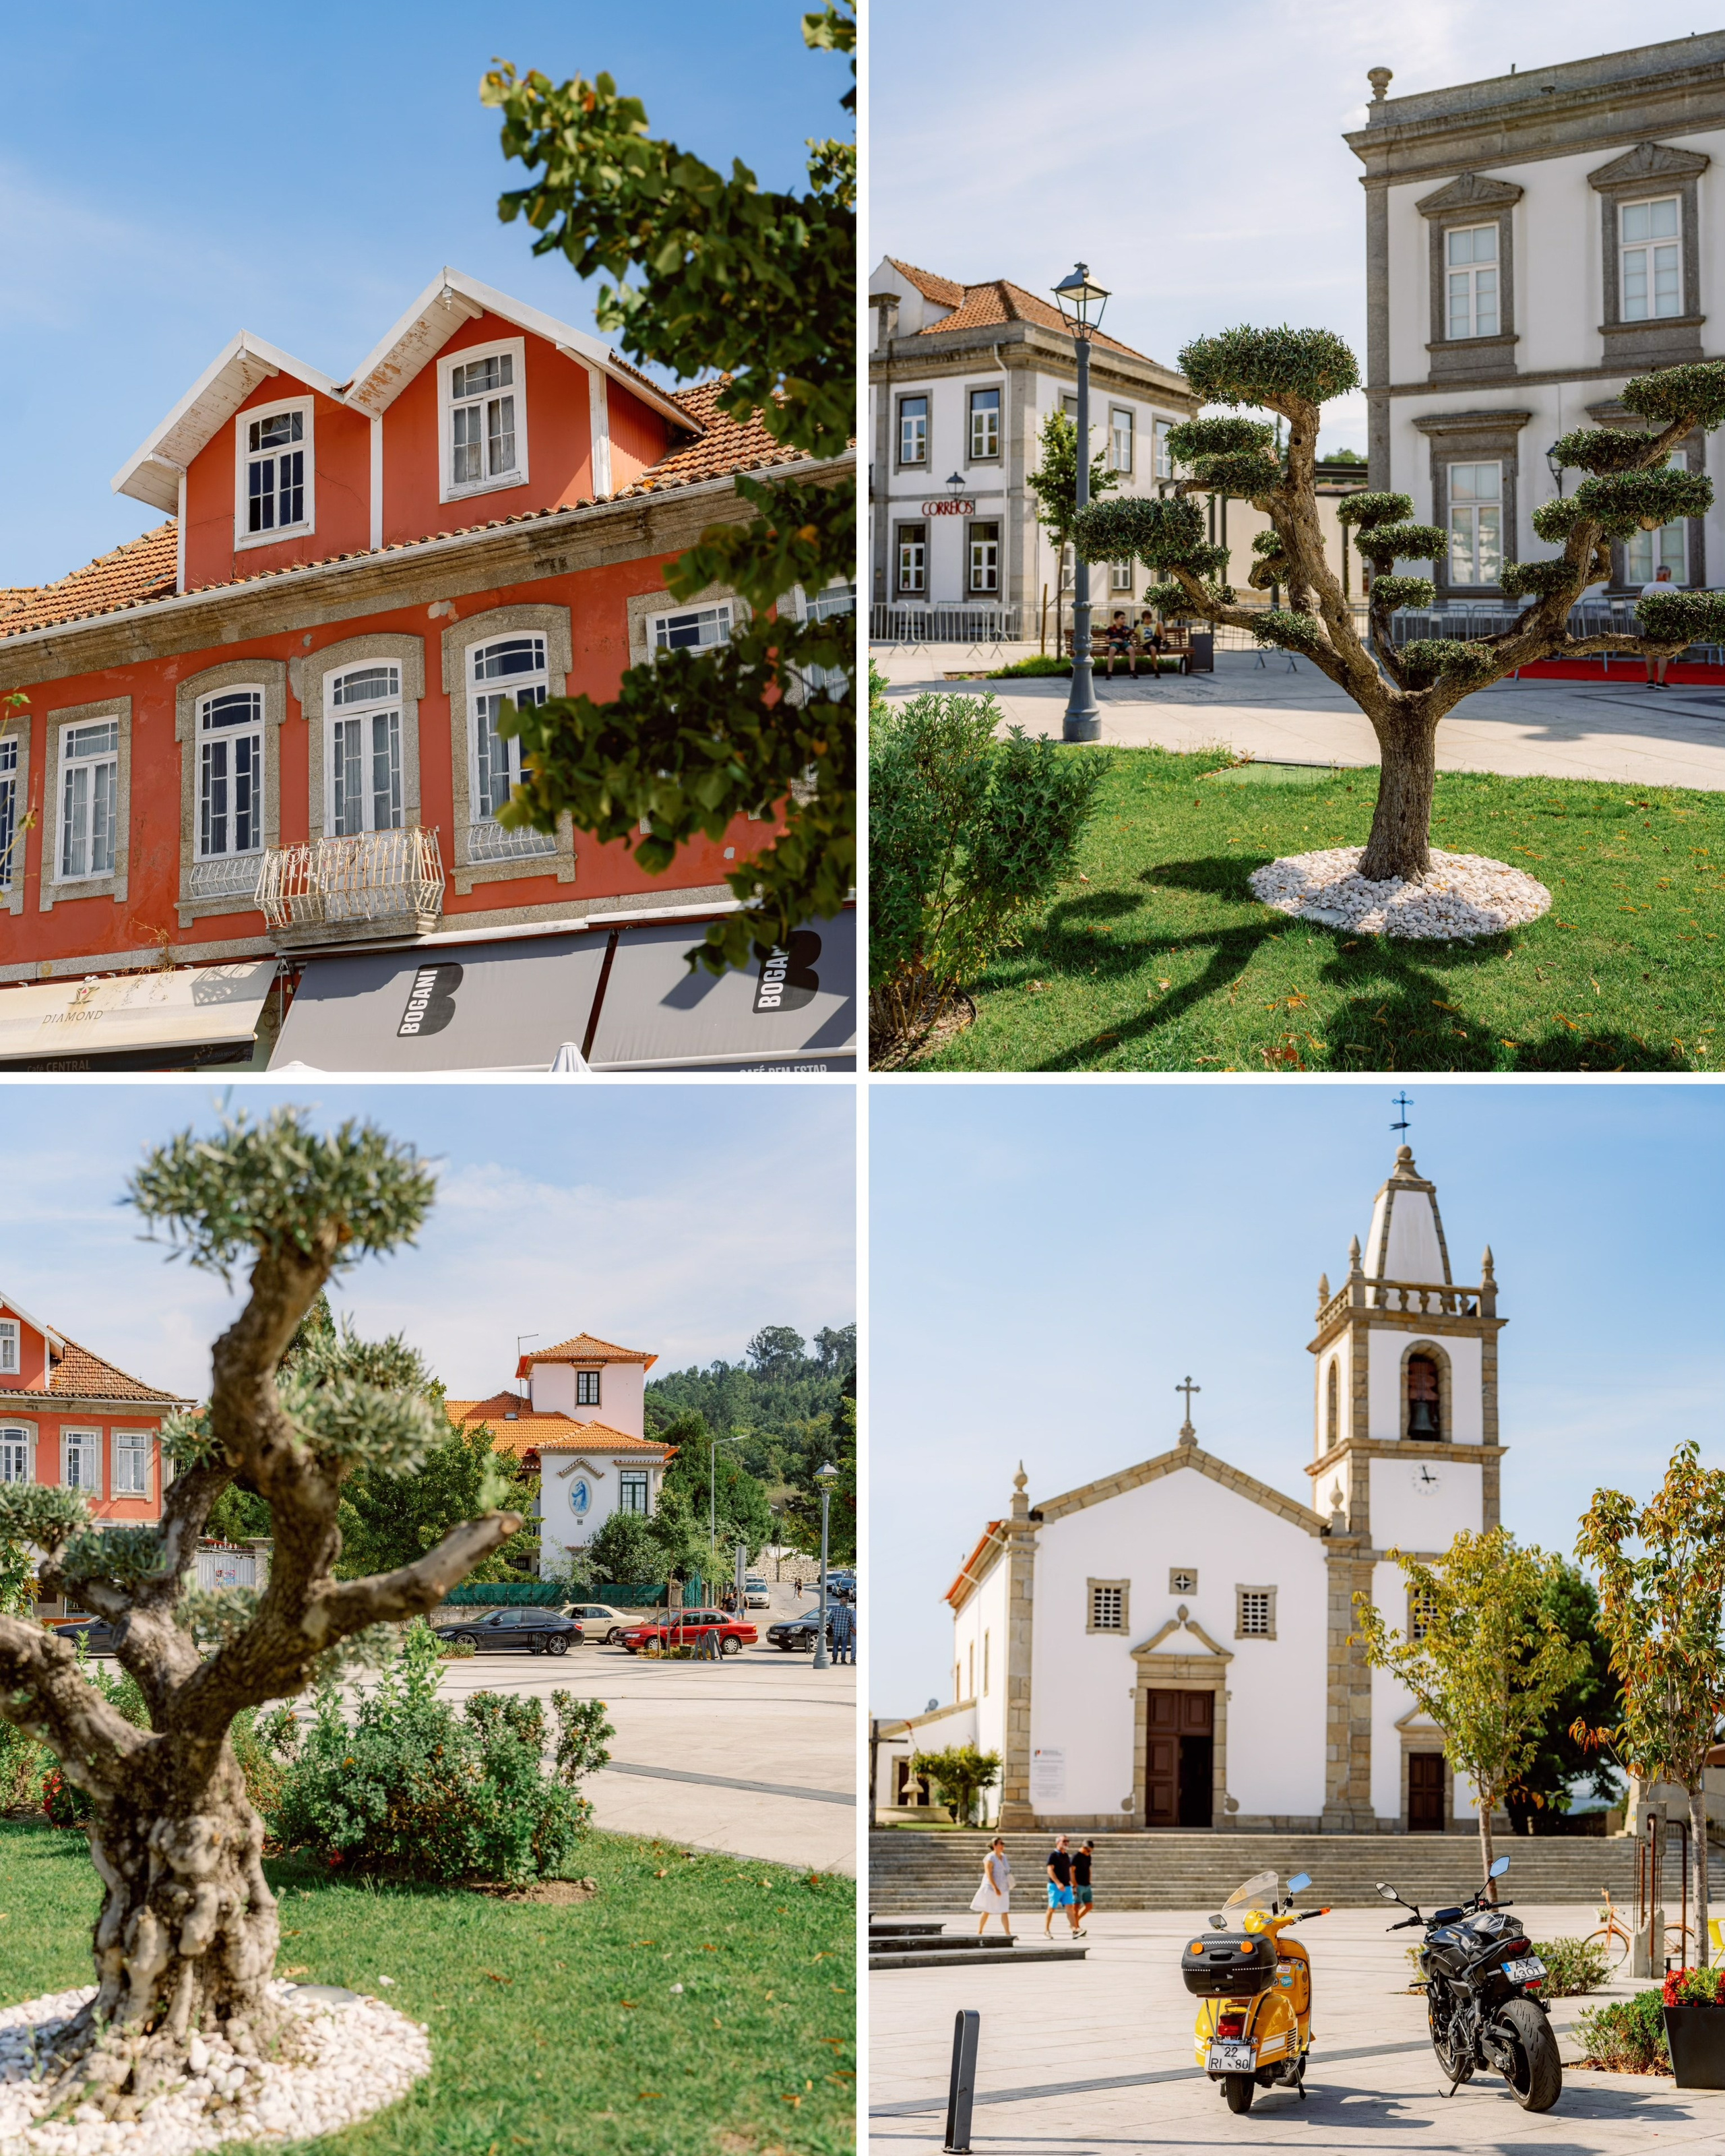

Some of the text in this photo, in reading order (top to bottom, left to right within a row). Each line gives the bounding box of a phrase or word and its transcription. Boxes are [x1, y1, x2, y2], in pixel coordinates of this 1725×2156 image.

[922, 501, 973, 517] CORREIOS
[400, 971, 437, 1034] BOGANI
[42, 1010, 103, 1024] DIAMOND
[46, 1059, 91, 1072] CENTRAL
[1515, 1959, 1532, 1970] AX
[1224, 2047, 1238, 2058] 22
[1210, 2058, 1249, 2069] RI 80
